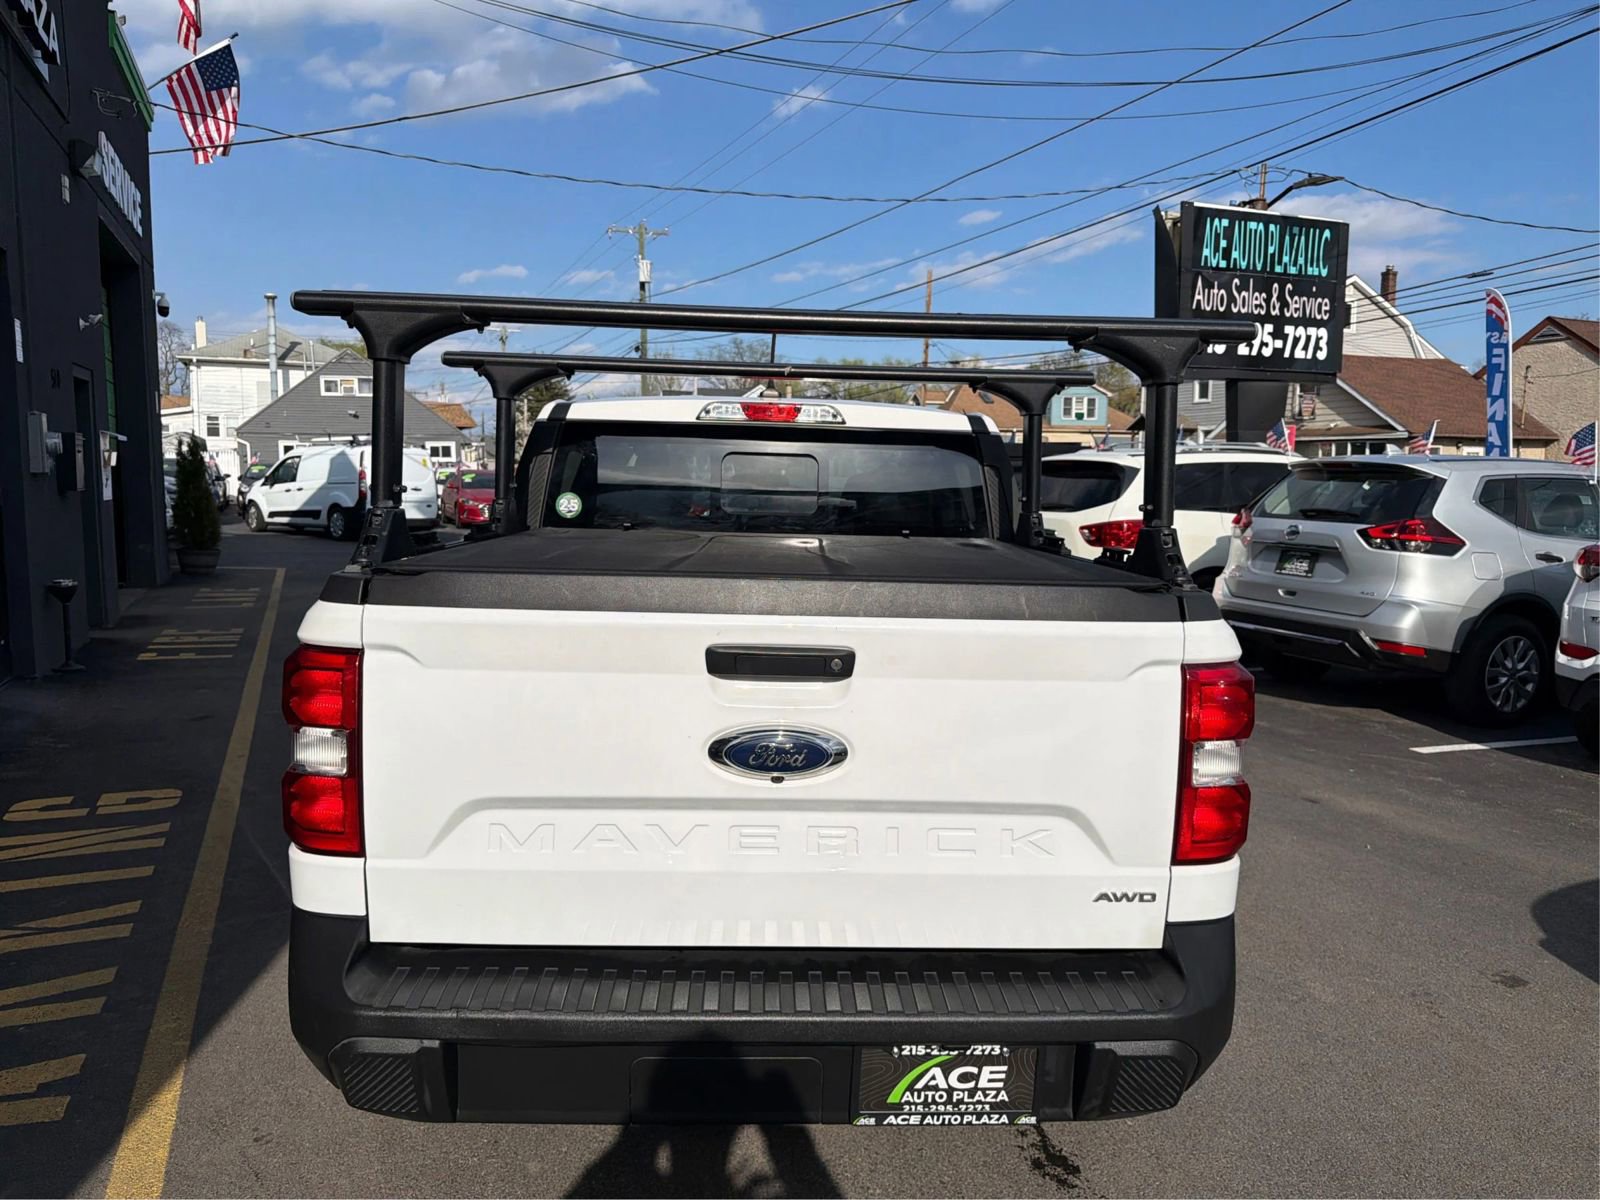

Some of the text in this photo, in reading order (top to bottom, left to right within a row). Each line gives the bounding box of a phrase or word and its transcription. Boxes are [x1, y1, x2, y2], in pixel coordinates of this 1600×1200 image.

[98, 131, 143, 237] SERVICE
[1201, 217, 1331, 278] ACE AUTO PLAZA LLC
[1192, 275, 1330, 320] Auto Sales & Service
[750, 742, 807, 767] Ford
[487, 822, 1056, 858] MAVERICK
[1092, 891, 1156, 902] AWD
[913, 1065, 1008, 1089] ACE
[901, 1090, 1009, 1103] AUTO PLAZA
[882, 1114, 922, 1125] ACE
[923, 1114, 961, 1125] AUTO
[962, 1114, 1009, 1125] PLAZA
